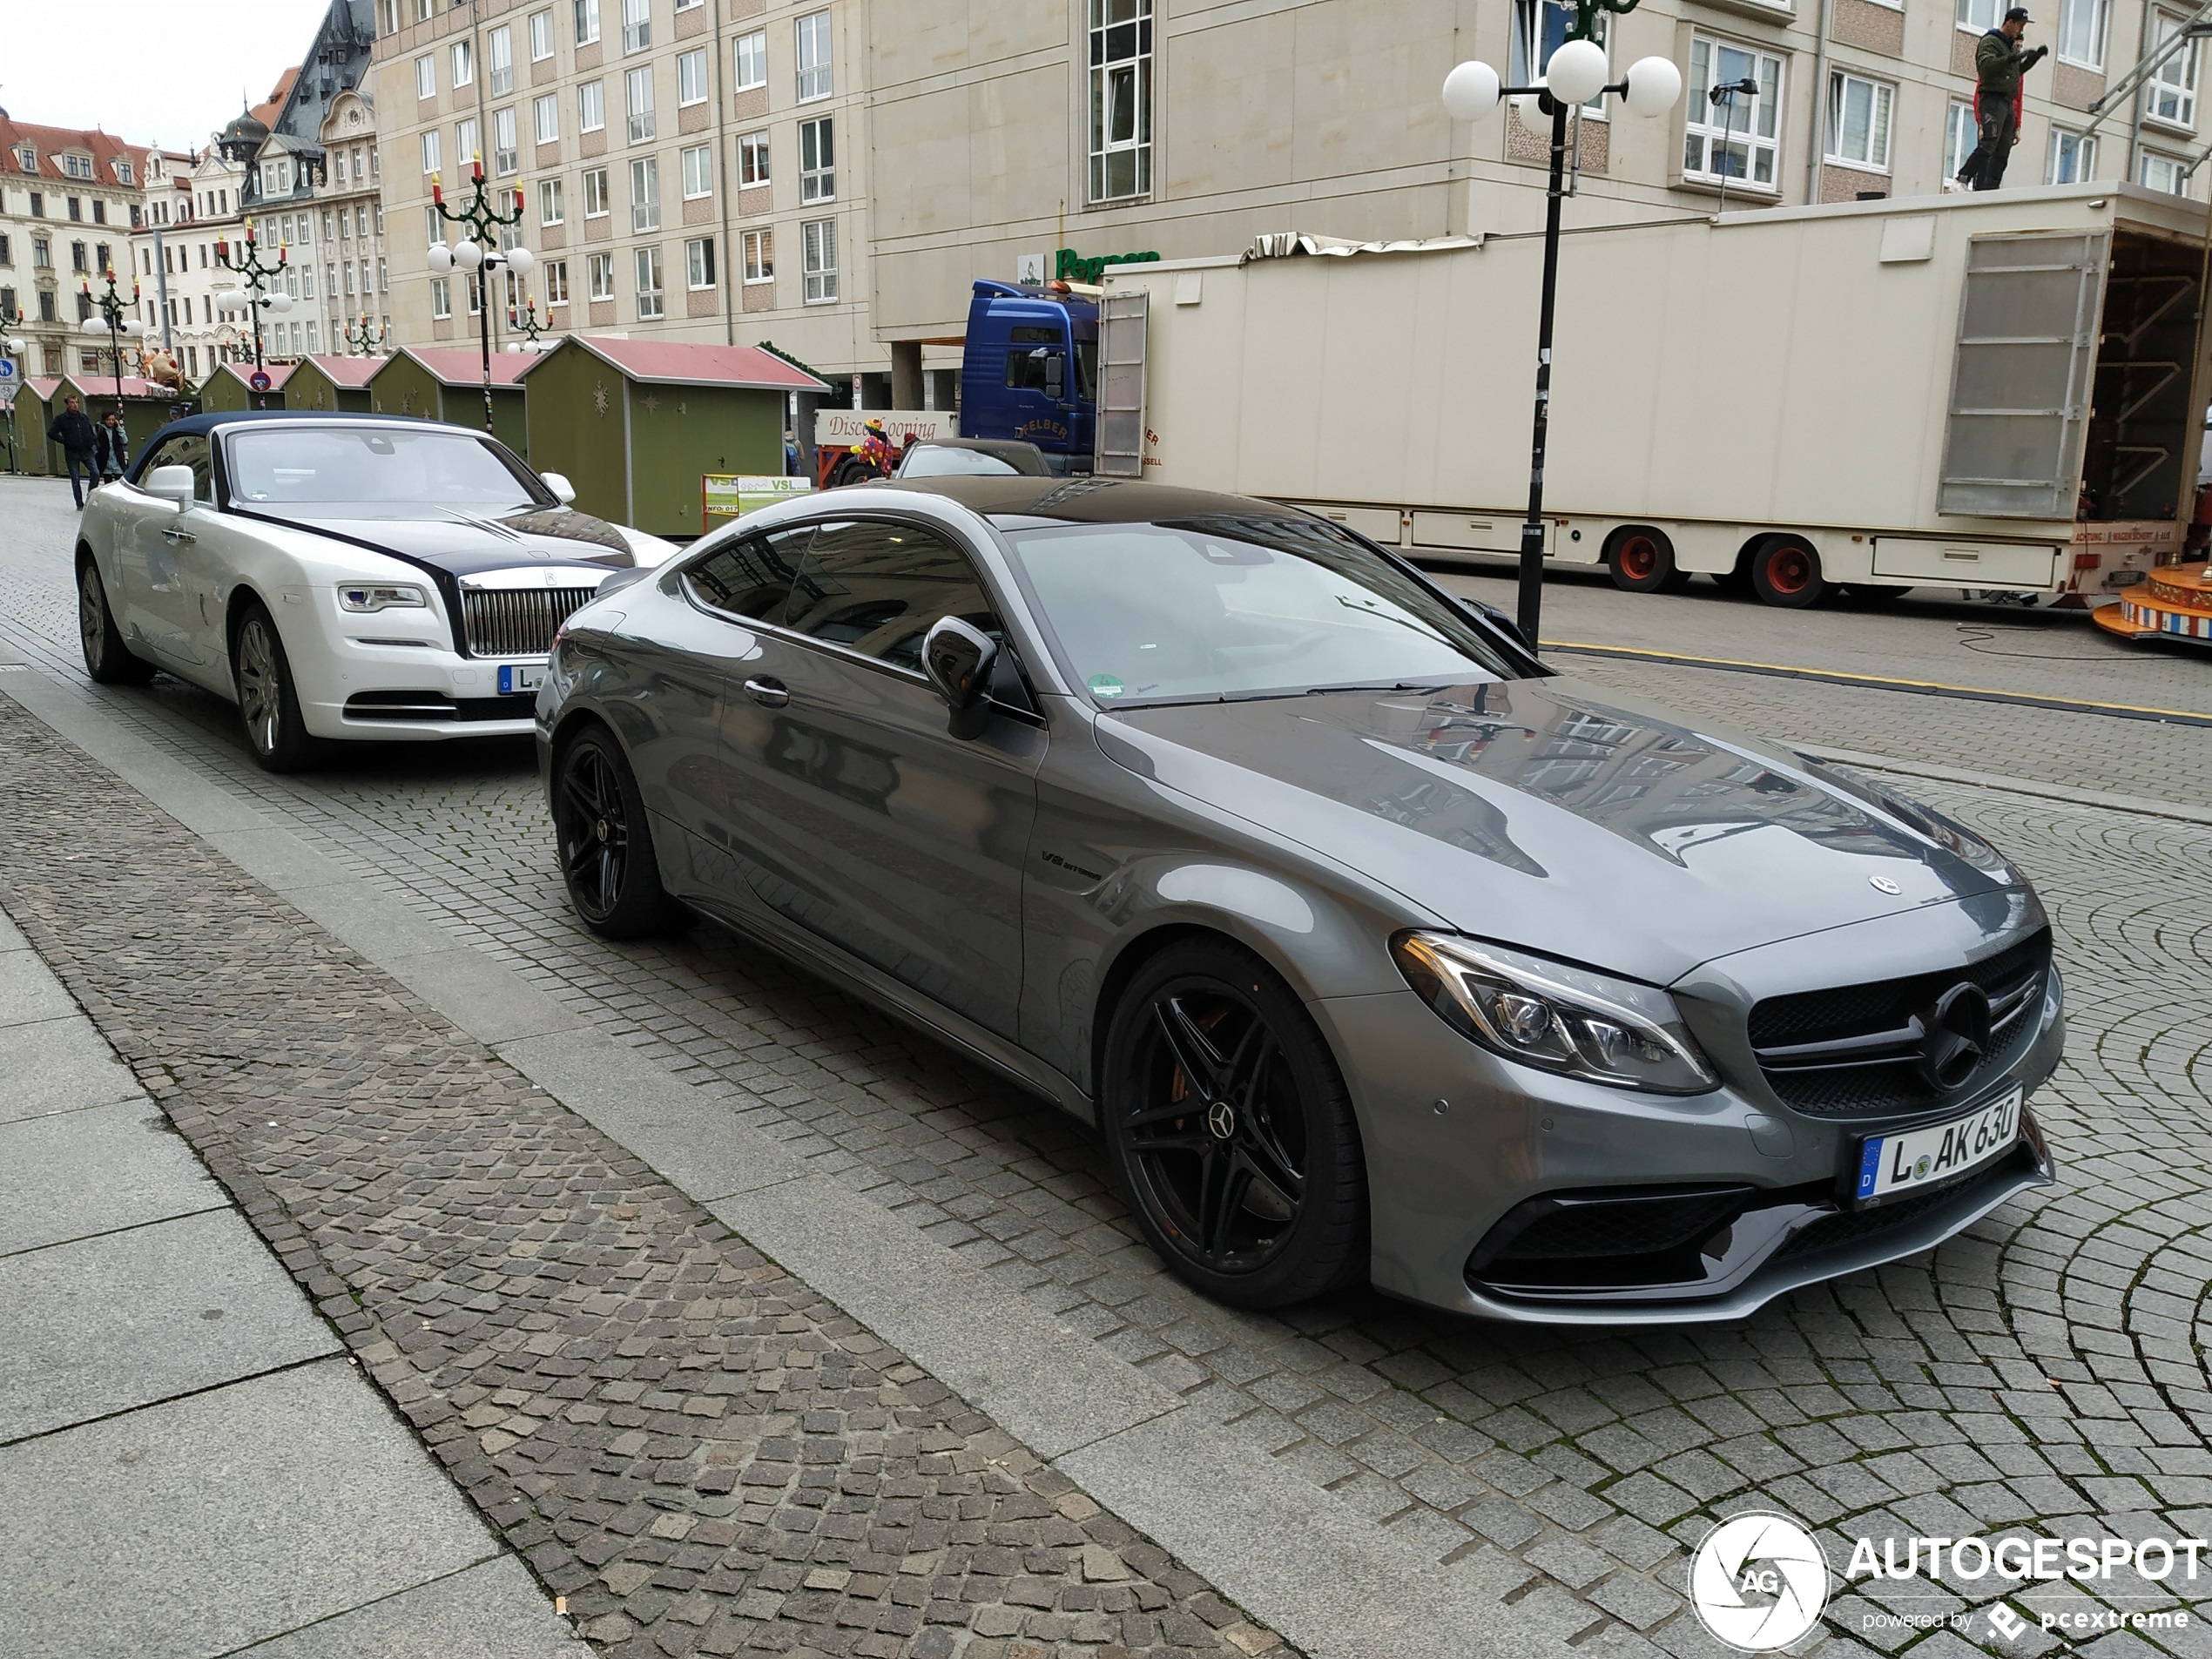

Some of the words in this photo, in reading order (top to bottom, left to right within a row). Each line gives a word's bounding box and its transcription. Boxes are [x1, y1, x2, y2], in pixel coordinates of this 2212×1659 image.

[880, 416, 937, 440] ooping
[1022, 418, 1069, 440] FELBER
[772, 480, 796, 490] VSL
[520, 669, 532, 688] L
[1042, 850, 1064, 867] V8
[1891, 1141, 1912, 1184] L
[1933, 1118, 1976, 1172] AK
[1974, 1096, 2015, 1155] 630
[1862, 1174, 1871, 1188] D
